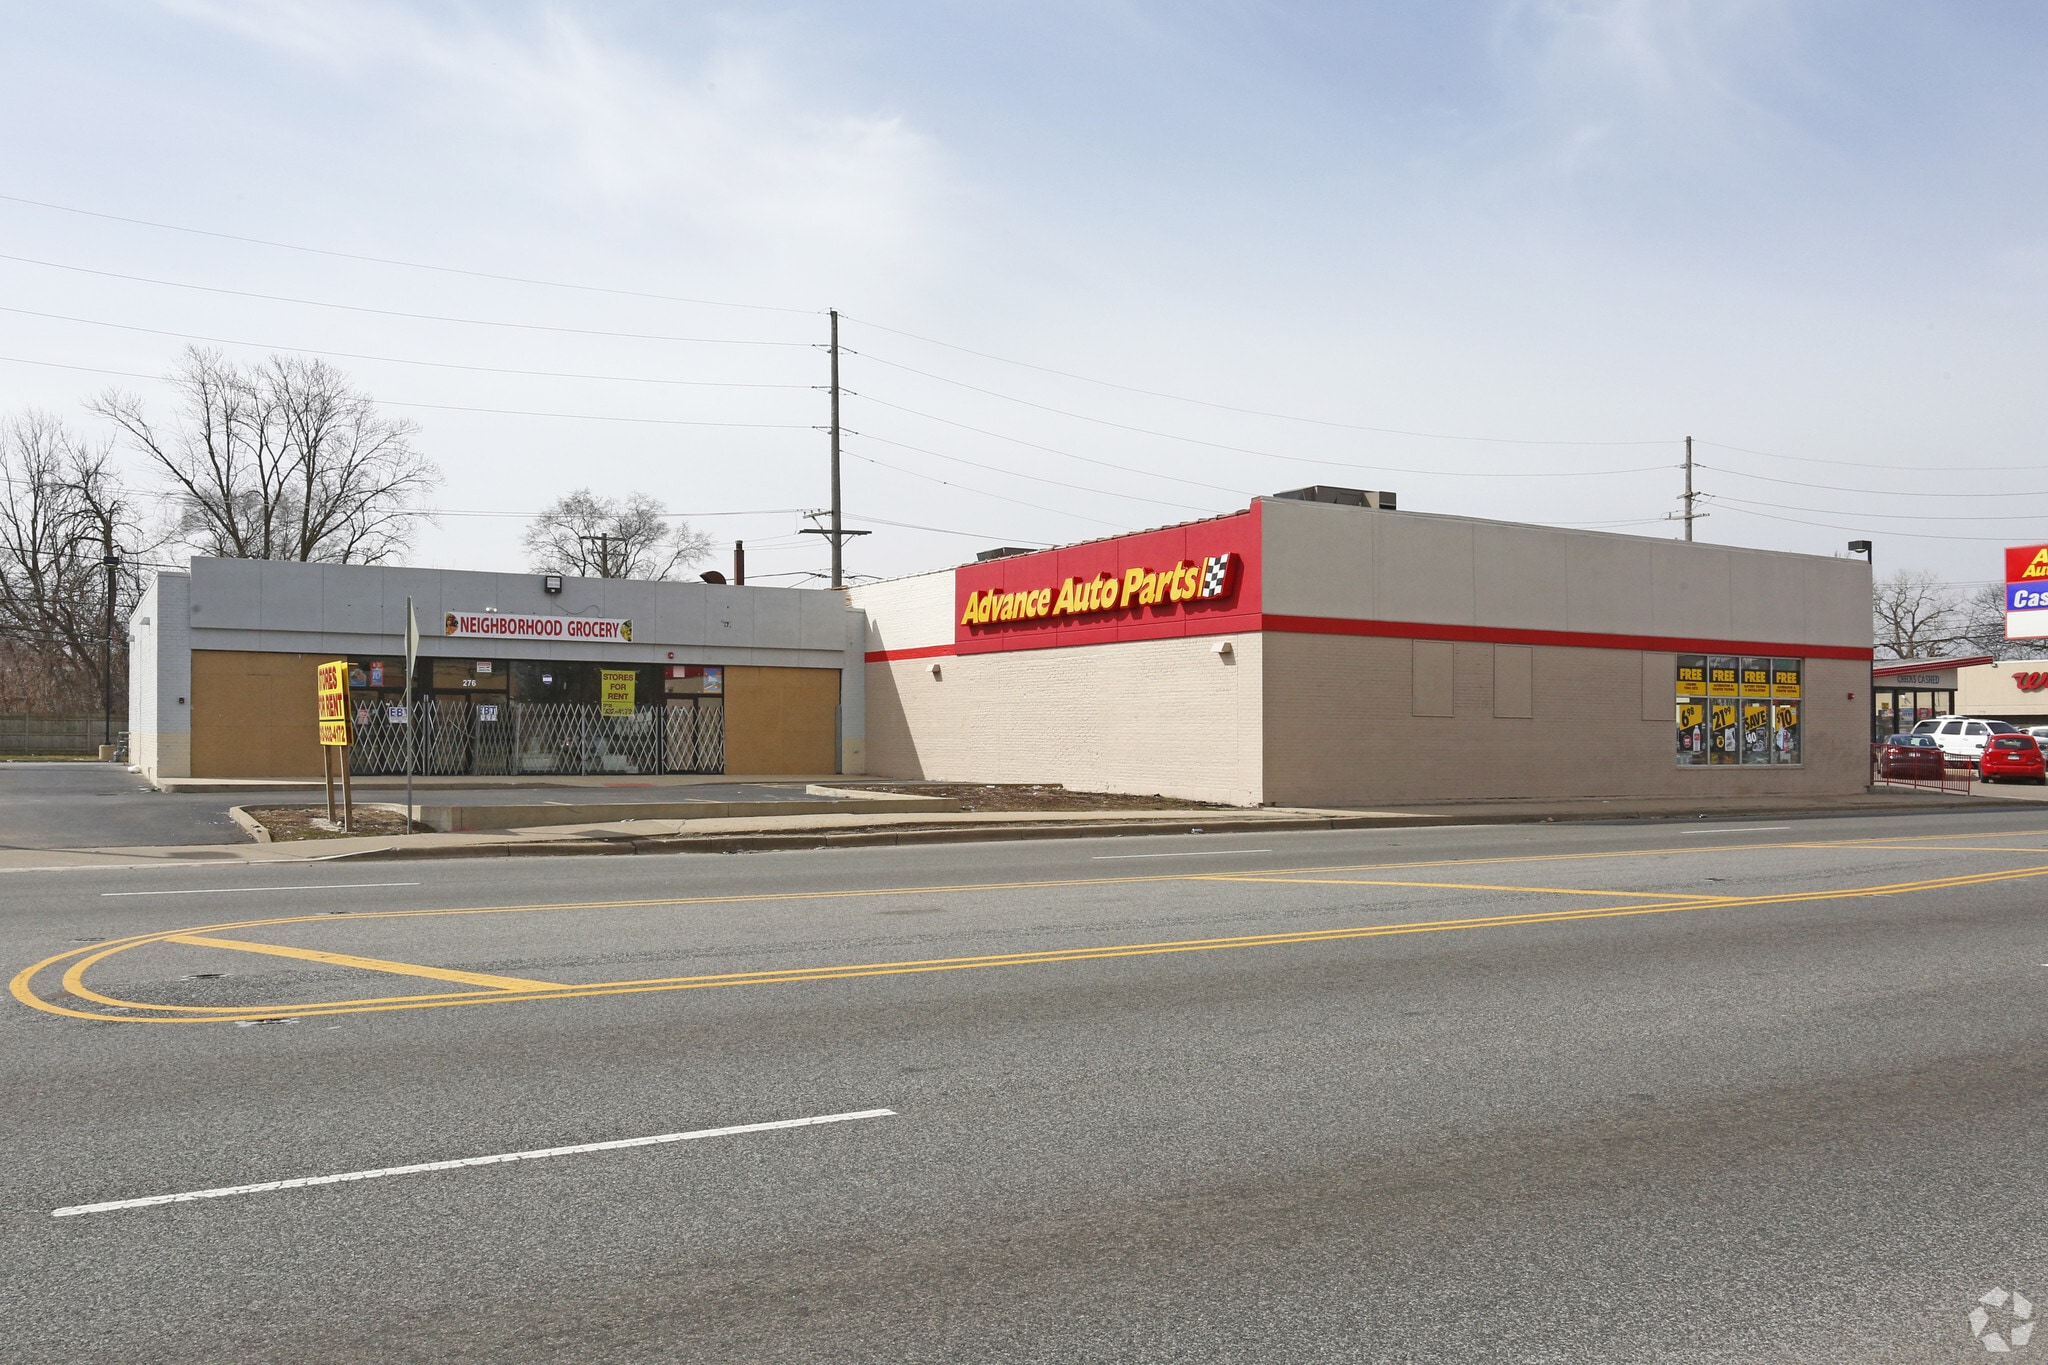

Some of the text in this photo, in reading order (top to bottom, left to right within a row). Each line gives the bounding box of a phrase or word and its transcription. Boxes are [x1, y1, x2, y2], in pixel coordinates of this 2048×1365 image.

[2022, 564, 2048, 578] Au
[961, 560, 1199, 625] Advance Auto Parts
[460, 616, 620, 638] NEIGHBORHOOD GROCERY
[603, 673, 634, 681] STORES
[1680, 668, 1703, 681] FREE
[1713, 669, 1735, 682] FREE
[1744, 671, 1766, 683] FREE
[1776, 672, 1797, 684] FREE
[1918, 675, 1939, 684] CASHED
[463, 679, 477, 687] 276
[610, 683, 626, 691] FOR
[608, 692, 629, 700] RENT
[326, 693, 342, 717] RENT
[1745, 710, 1766, 730] SAVE
